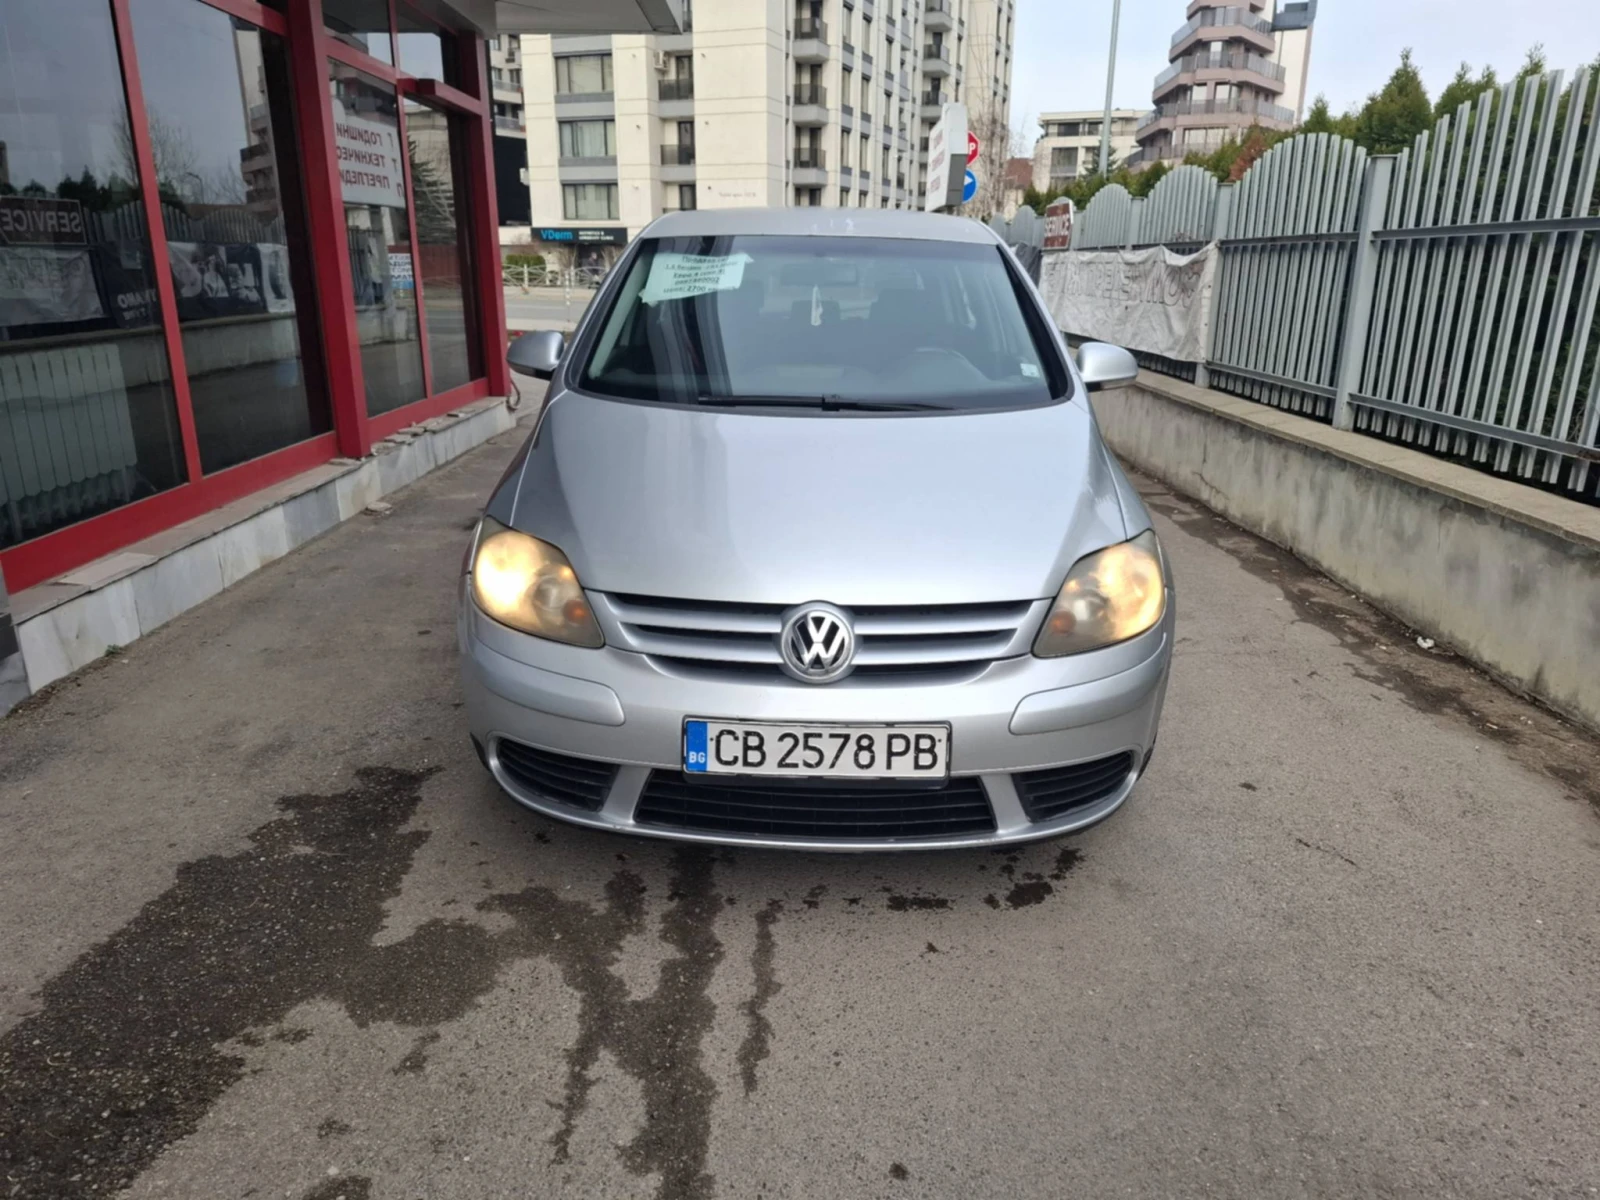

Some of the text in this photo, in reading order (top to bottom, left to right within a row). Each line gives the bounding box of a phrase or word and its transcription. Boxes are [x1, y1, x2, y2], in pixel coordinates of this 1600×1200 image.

[541, 229, 573, 240] VDerm
[715, 729, 939, 771] CB 2578 PB
[688, 751, 706, 764] BG
